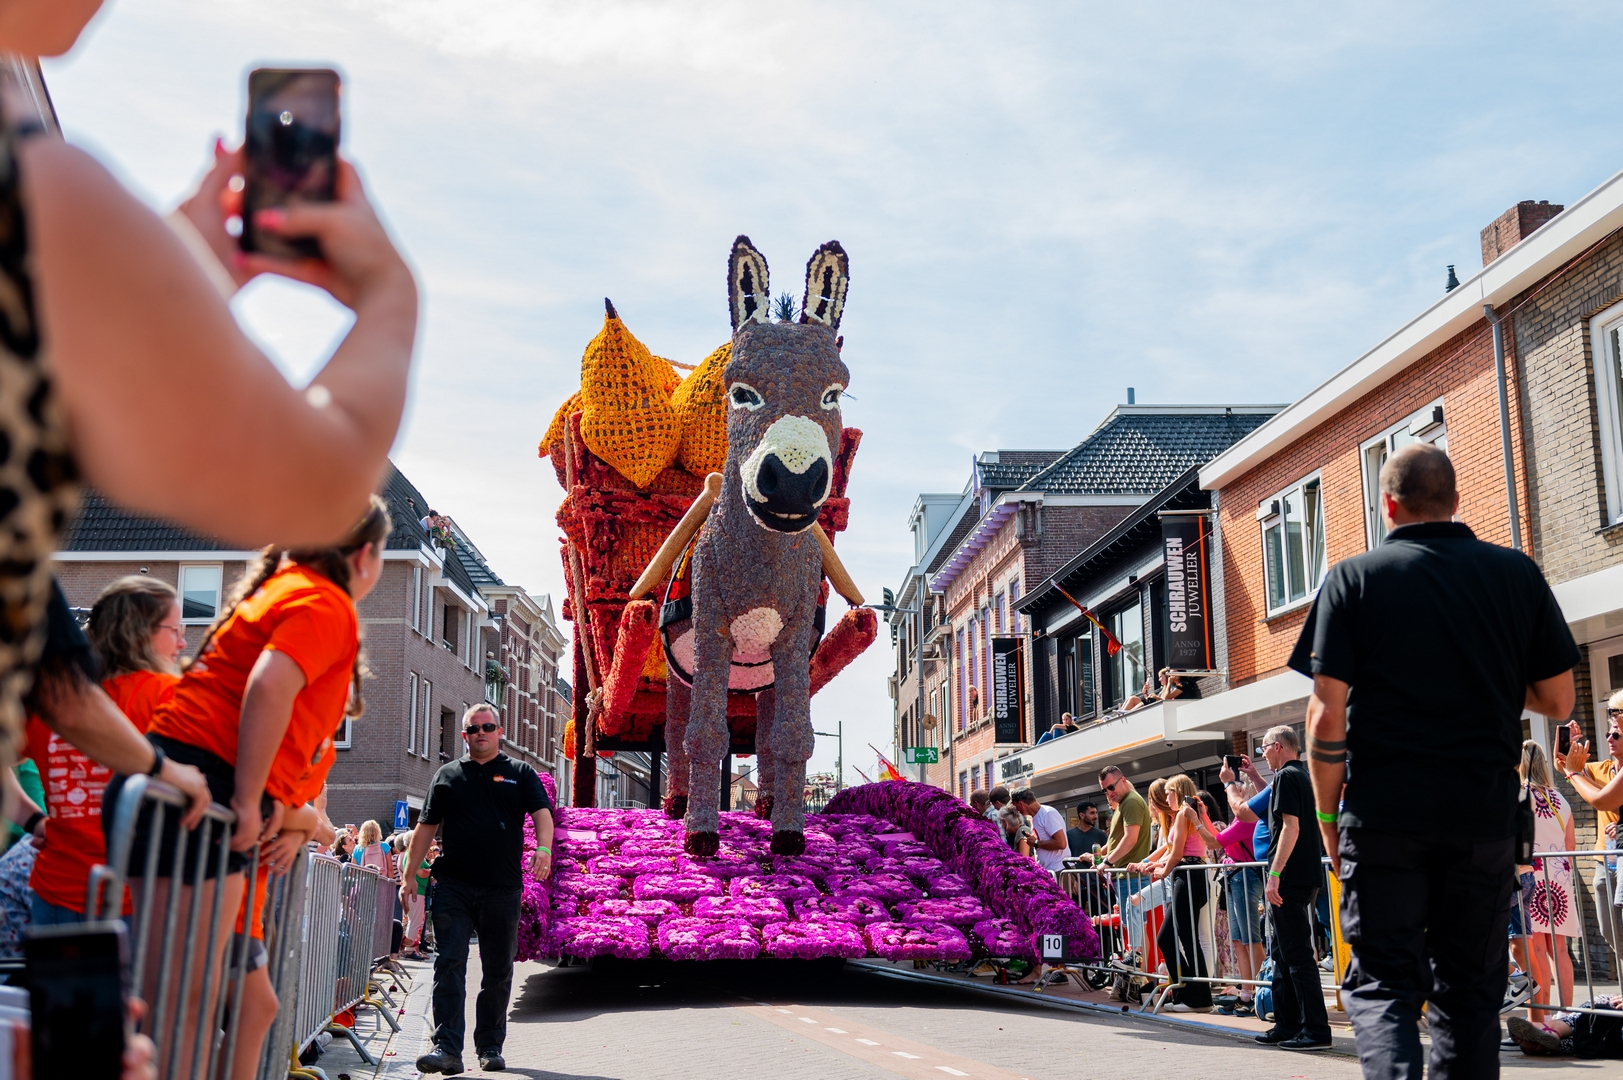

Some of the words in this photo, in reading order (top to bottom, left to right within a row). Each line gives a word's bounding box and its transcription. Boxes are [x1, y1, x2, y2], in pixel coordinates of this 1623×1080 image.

[1166, 537, 1187, 633] SCHRAUWEN
[1186, 551, 1202, 618] JUWELIER
[1174, 640, 1201, 648] ANNO
[995, 652, 1008, 719] SCHRAUWEN
[1008, 662, 1018, 708] JUWELIER
[1045, 937, 1061, 950] 10
